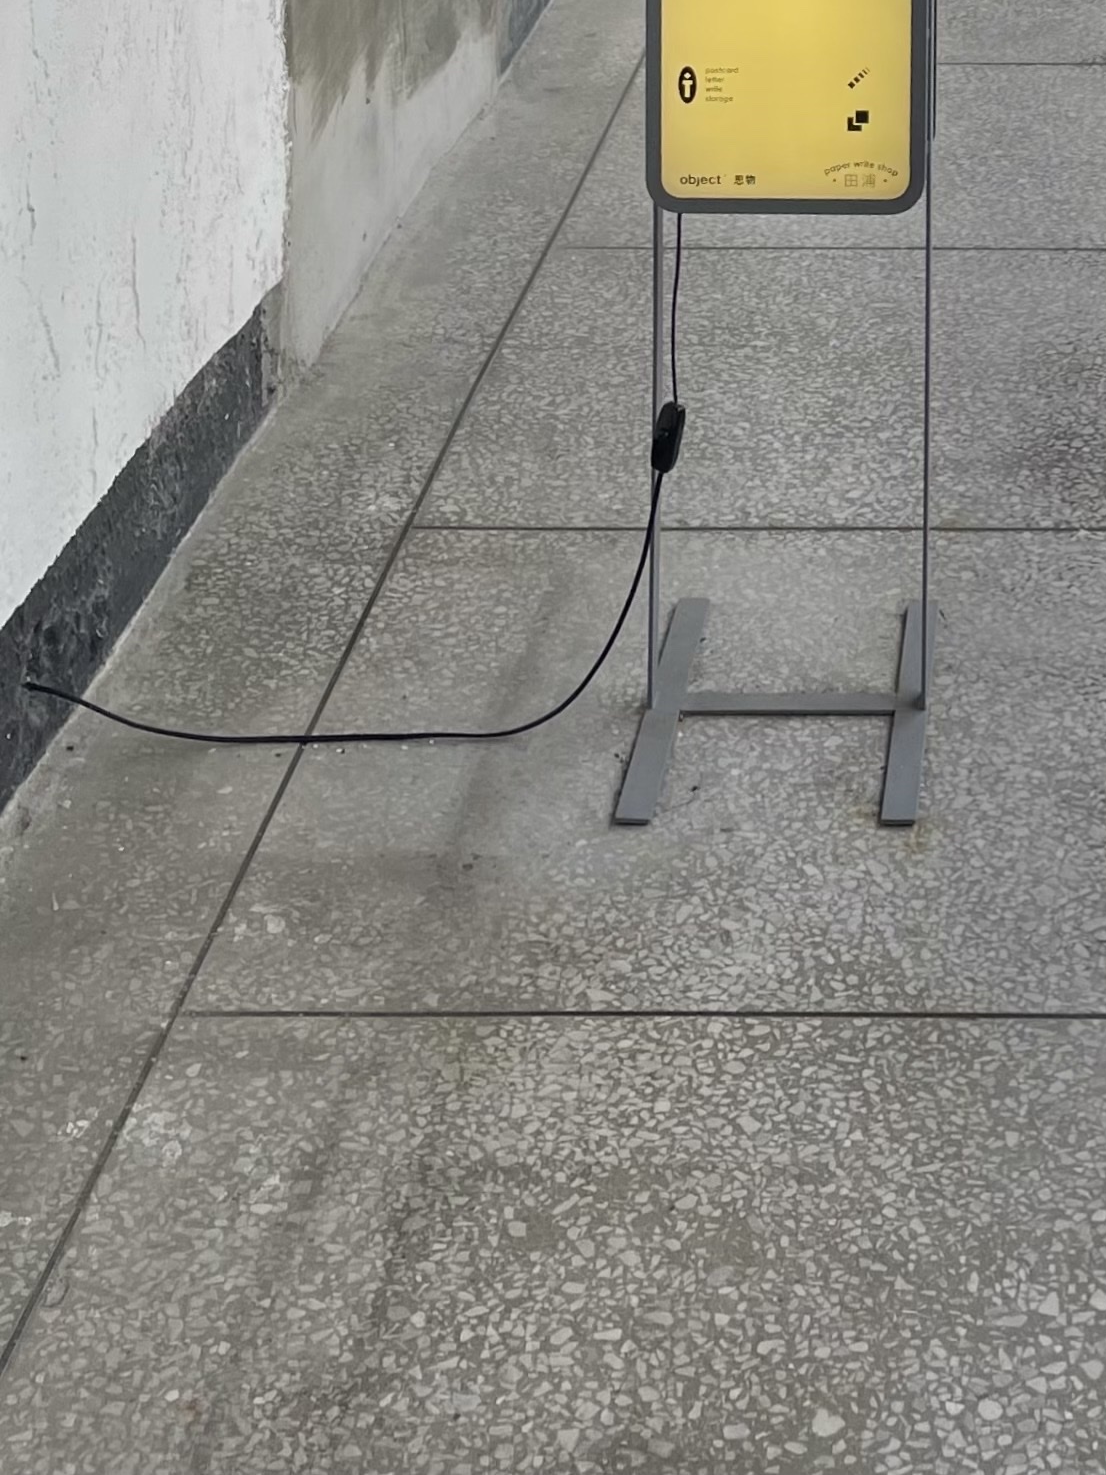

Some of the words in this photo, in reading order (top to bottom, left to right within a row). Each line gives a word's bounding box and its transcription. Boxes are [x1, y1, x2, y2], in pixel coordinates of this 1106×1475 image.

[705, 67, 740, 75] postcard
[705, 96, 734, 104] storage
[824, 162, 850, 176] paper
[853, 160, 875, 169] write
[877, 163, 899, 177] shop
[680, 173, 722, 187] object
